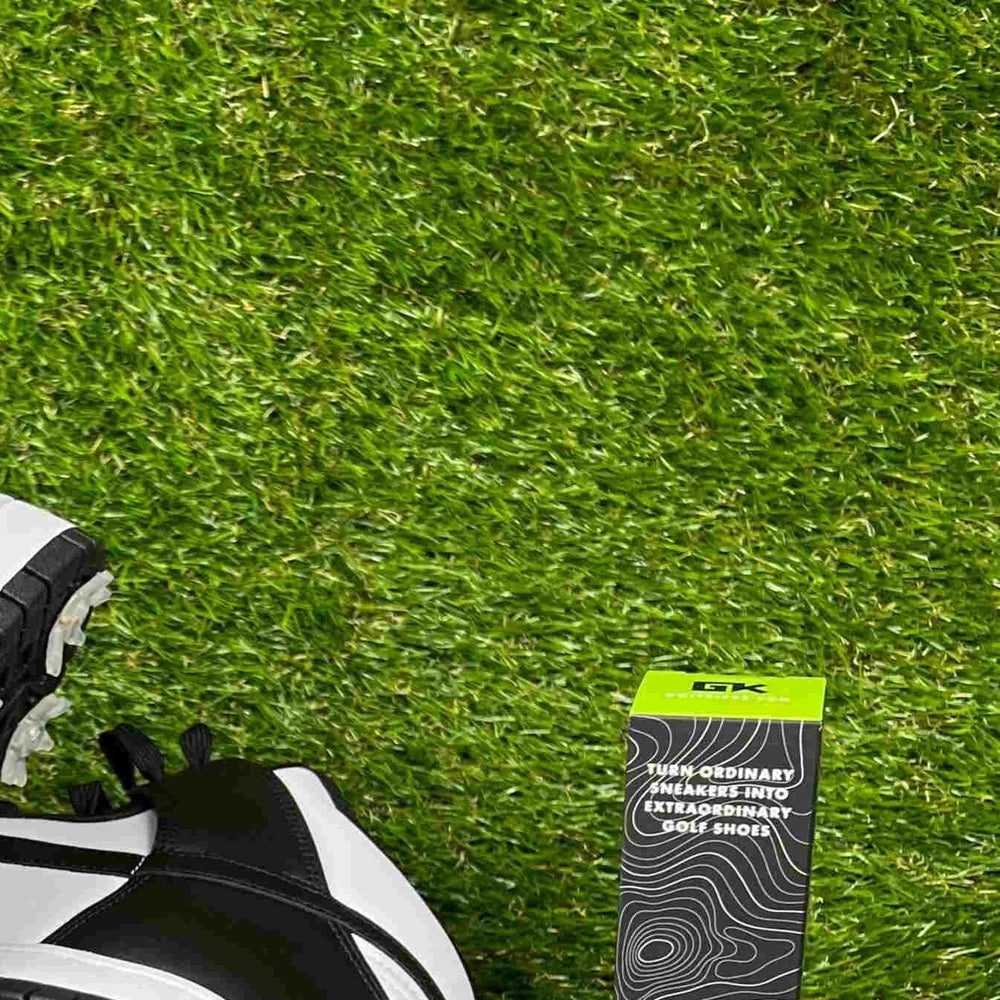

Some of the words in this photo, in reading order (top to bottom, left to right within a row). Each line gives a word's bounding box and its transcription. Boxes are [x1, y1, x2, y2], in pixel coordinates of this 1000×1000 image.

[692, 680, 767, 694] GK
[646, 762, 693, 778] TURN
[697, 766, 795, 782] ORDINARY
[650, 782, 739, 799] SNEAKERS
[744, 786, 789, 800] INTO
[644, 800, 792, 820] EXTRAORDINARY
[661, 820, 709, 834] GOLF
[713, 823, 771, 837] SHOES
